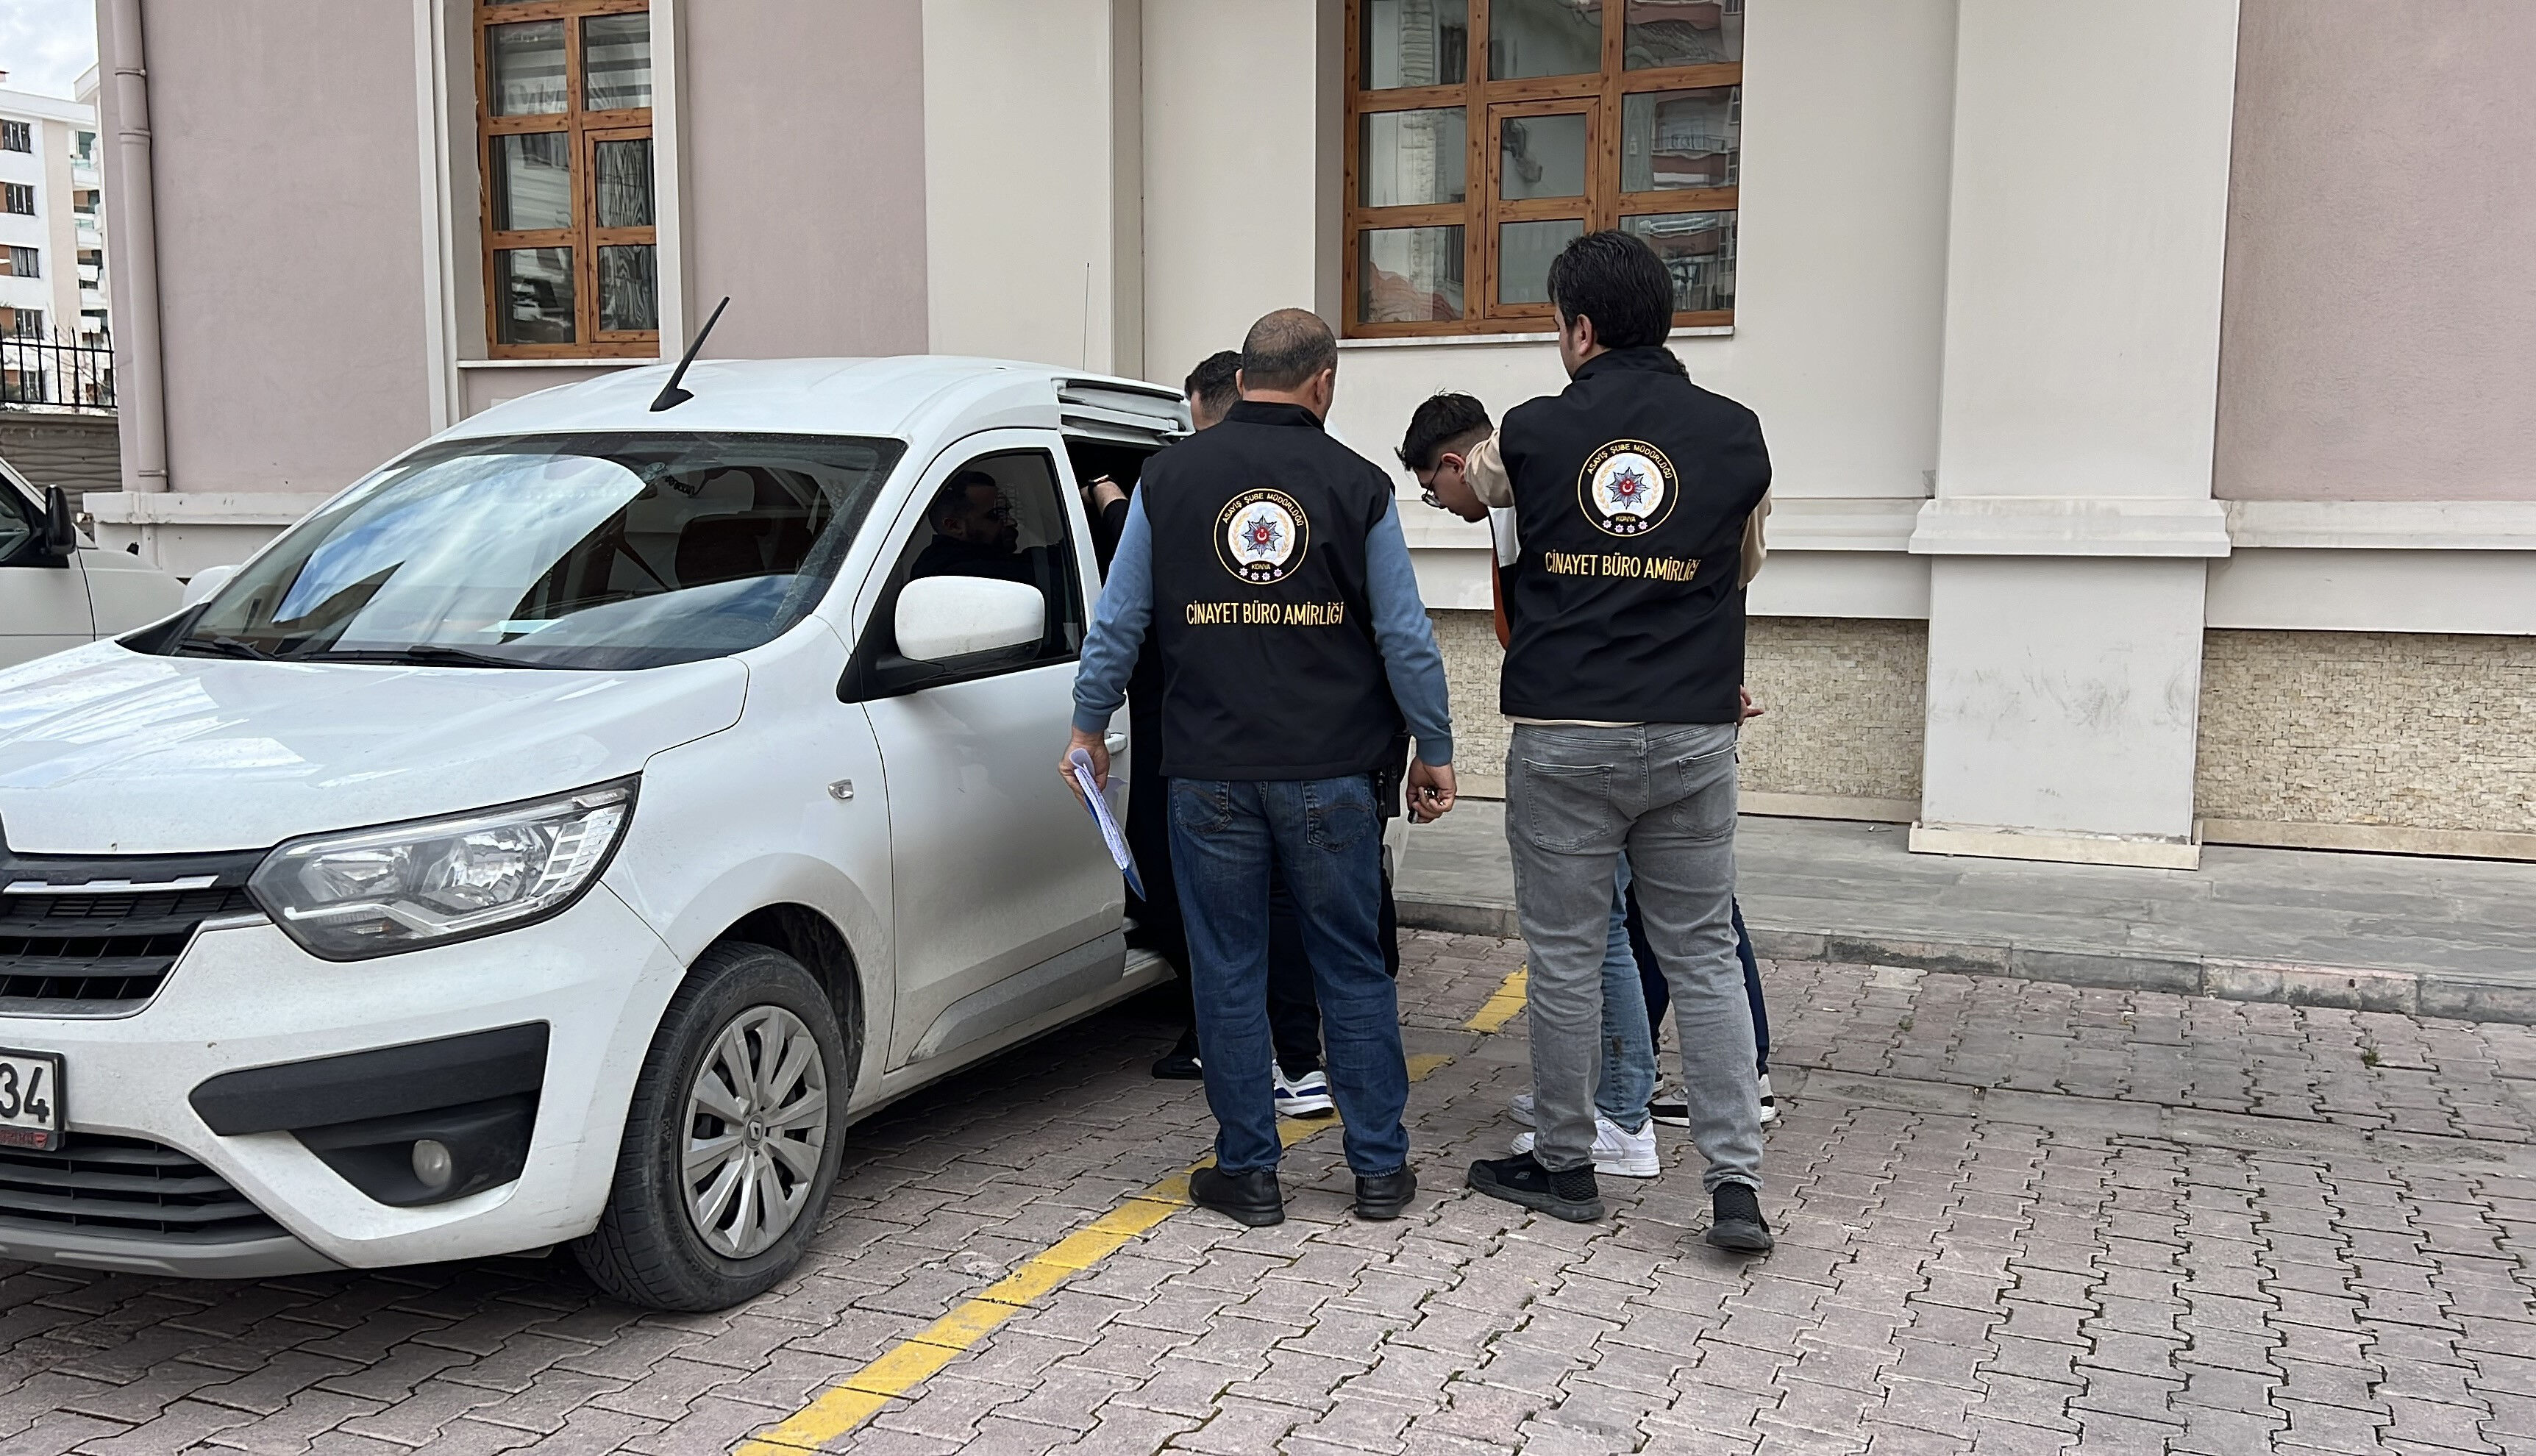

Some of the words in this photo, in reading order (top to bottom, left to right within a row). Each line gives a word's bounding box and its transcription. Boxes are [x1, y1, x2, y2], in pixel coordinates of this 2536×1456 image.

[1609, 443, 1631, 454] ŞUBE
[1244, 493, 1264, 504] ŞUBE
[1545, 549, 1598, 576] CİNAYET
[1602, 552, 1641, 577] BÜRO
[1186, 600, 1239, 625] CİNAYET
[1243, 600, 1280, 624] BÜRO
[1283, 601, 1344, 625] AMİRLİĞİ
[0, 1063, 50, 1123] 34
